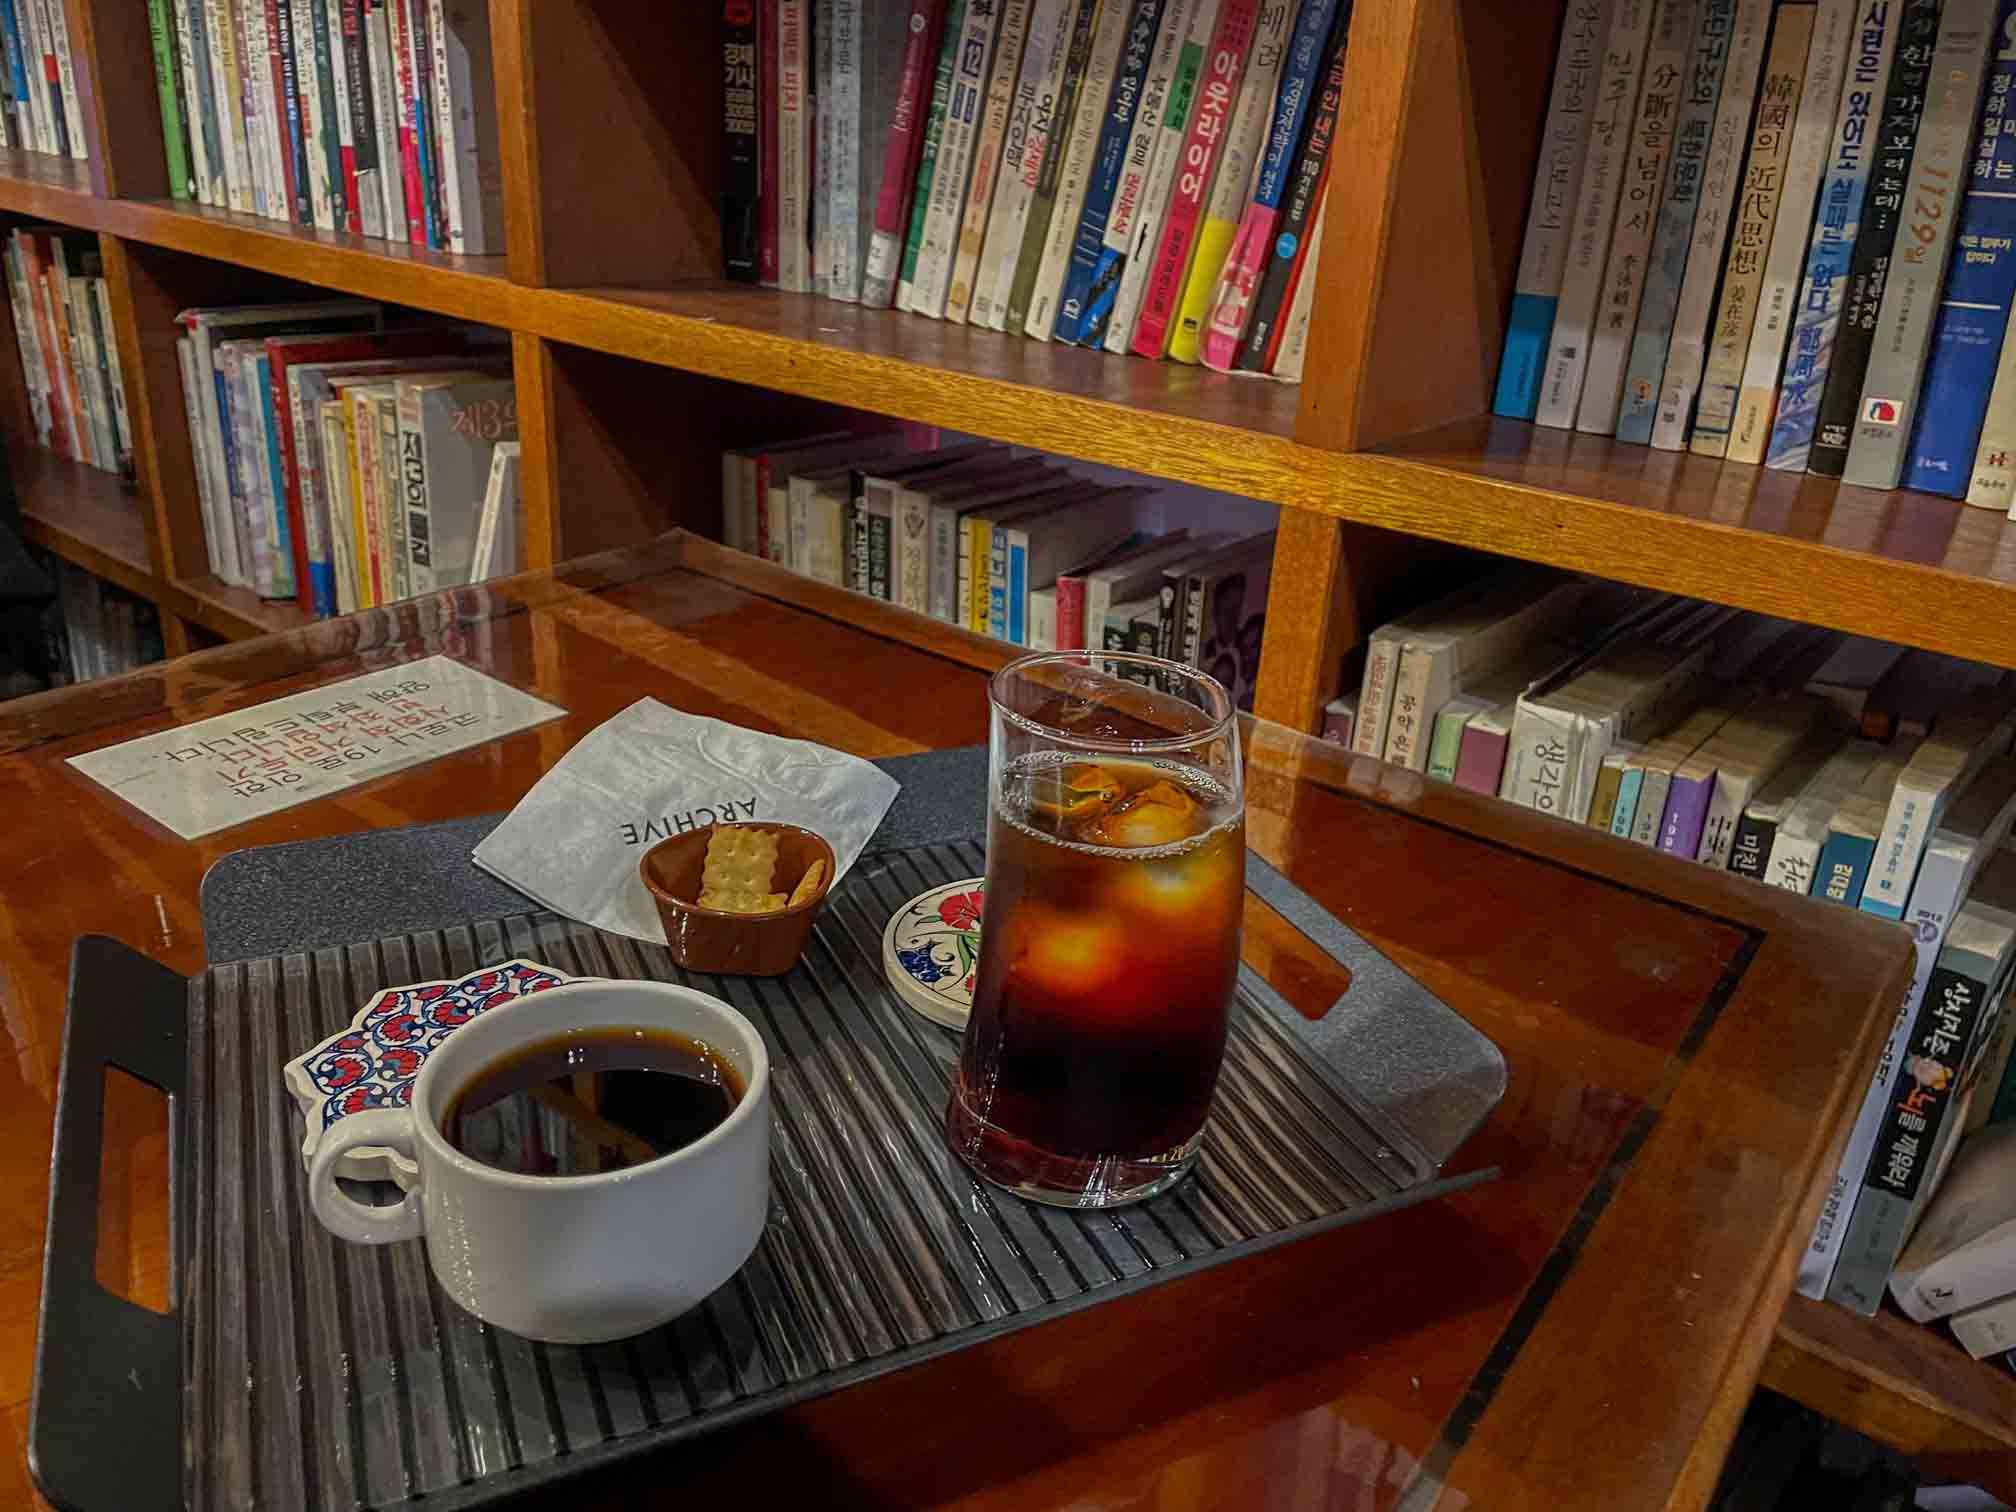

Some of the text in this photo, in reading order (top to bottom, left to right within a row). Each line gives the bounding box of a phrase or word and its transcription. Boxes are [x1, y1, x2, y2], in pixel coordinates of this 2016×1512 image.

[1181, 50, 1240, 203] 아웃라이어
[1753, 73, 1798, 158] 韓國의
[1836, 91, 1871, 173] 있어도
[1624, 154, 1660, 236] 넘어서
[1728, 165, 1777, 276] 近代思想
[1805, 264, 1835, 316] 없다
[153, 681, 430, 763] 양해 부탁드립니다.
[216, 705, 448, 787] 사회적 거리두기
[230, 712, 480, 798] 코로나 19로 인한
[623, 798, 757, 846] ARCHIVE
[1923, 982, 1971, 1056] 상식지존
[1897, 1090, 1937, 1131] 너를
[1880, 1133, 1920, 1189] 깨워라
